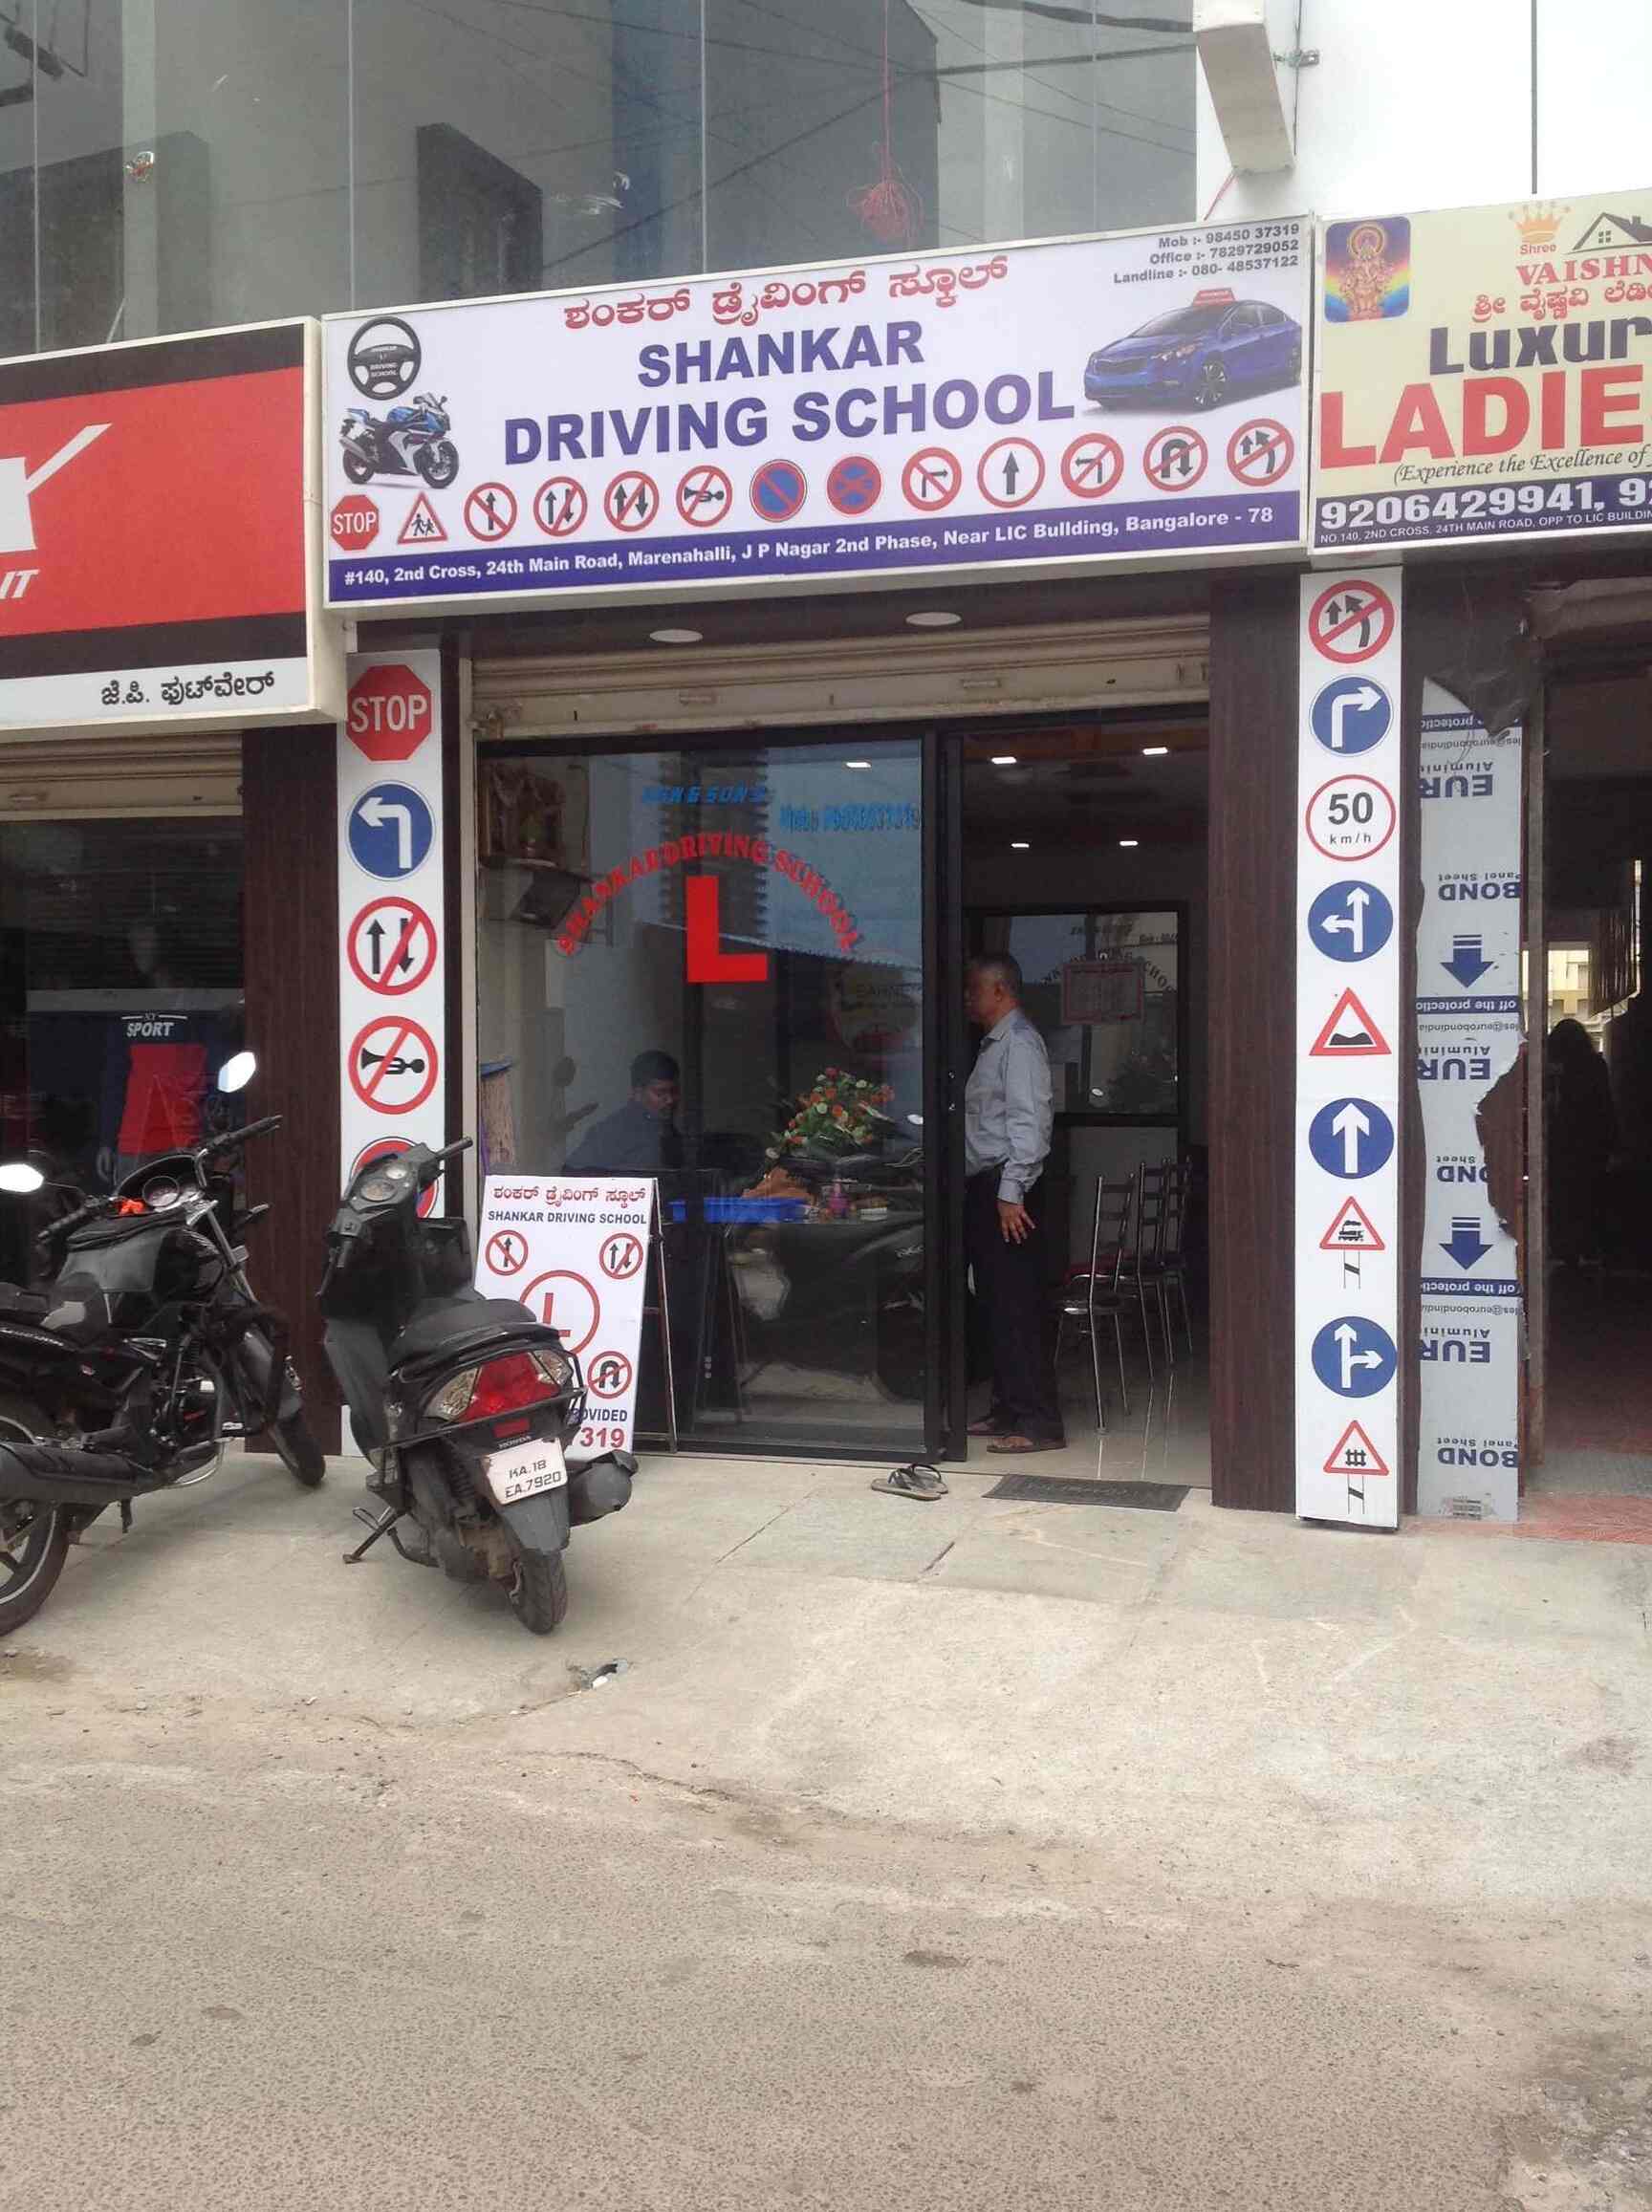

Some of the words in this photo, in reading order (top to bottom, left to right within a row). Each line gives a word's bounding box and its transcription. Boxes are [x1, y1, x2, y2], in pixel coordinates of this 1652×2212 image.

[1159, 236, 1188, 249] Mob
[1206, 228, 1250, 244] 98450
[1255, 223, 1300, 238] 37319
[1519, 243, 1557, 255] Shree
[1150, 251, 1192, 265] Office
[1209, 239, 1299, 259] 7829729052
[1114, 269, 1174, 284] Landline
[1227, 254, 1298, 273] 48537122
[564, 288, 691, 330] ಶಂಕರ್
[711, 271, 866, 327] ಡ್ರೈವಿಂಗ್
[888, 254, 1010, 309] ಸ್ಕೂಲ್
[638, 319, 925, 387] SHANKAR
[505, 396, 768, 466] DRIVING
[793, 370, 1076, 442] SCHOOL
[1498, 454, 1526, 473] the
[1530, 447, 1622, 472] Excellence
[1628, 443, 1651, 469] of
[1320, 482, 1605, 530] 9206429941,
[1619, 478, 1652, 507] 9
[333, 511, 377, 535] STOP
[1364, 529, 1387, 540] 2ND
[1436, 524, 1463, 534] 24TH
[1467, 520, 1496, 531] MAIN
[1538, 516, 1563, 526] OPP
[1567, 513, 1582, 524] TO
[1585, 512, 1604, 522] LIC
[344, 569, 390, 586] #140,
[394, 566, 424, 582] 2nd
[430, 564, 481, 579] Cross,
[486, 559, 524, 575] 24th
[529, 555, 570, 572] Main
[575, 553, 623, 570] Road,
[628, 545, 736, 566] Marenahalli,
[742, 543, 752, 559] J
[758, 543, 770, 558] P
[775, 540, 831, 559] Nagar
[836, 536, 869, 553] 2nd
[875, 533, 938, 551] Phase,
[944, 529, 989, 546] Near
[995, 525, 1027, 542] LIC
[1125, 511, 1229, 532] Bangalore
[1248, 507, 1273, 523] 78
[351, 694, 428, 734] STOP
[1328, 792, 1374, 825] 50
[1438, 881, 1521, 901] BOND
[685, 876, 768, 983] L
[1475, 1000, 1495, 1011] the
[1500, 1000, 1516, 1010] off
[126, 1022, 175, 1037] SPORT
[488, 1210, 544, 1223] SHANKAR
[547, 1212, 596, 1224] DRIVING
[599, 1213, 647, 1225] SCHOOL
[1474, 1283, 1494, 1294] the
[1498, 1284, 1515, 1294] off
[1437, 1447, 1519, 1468] BOND
